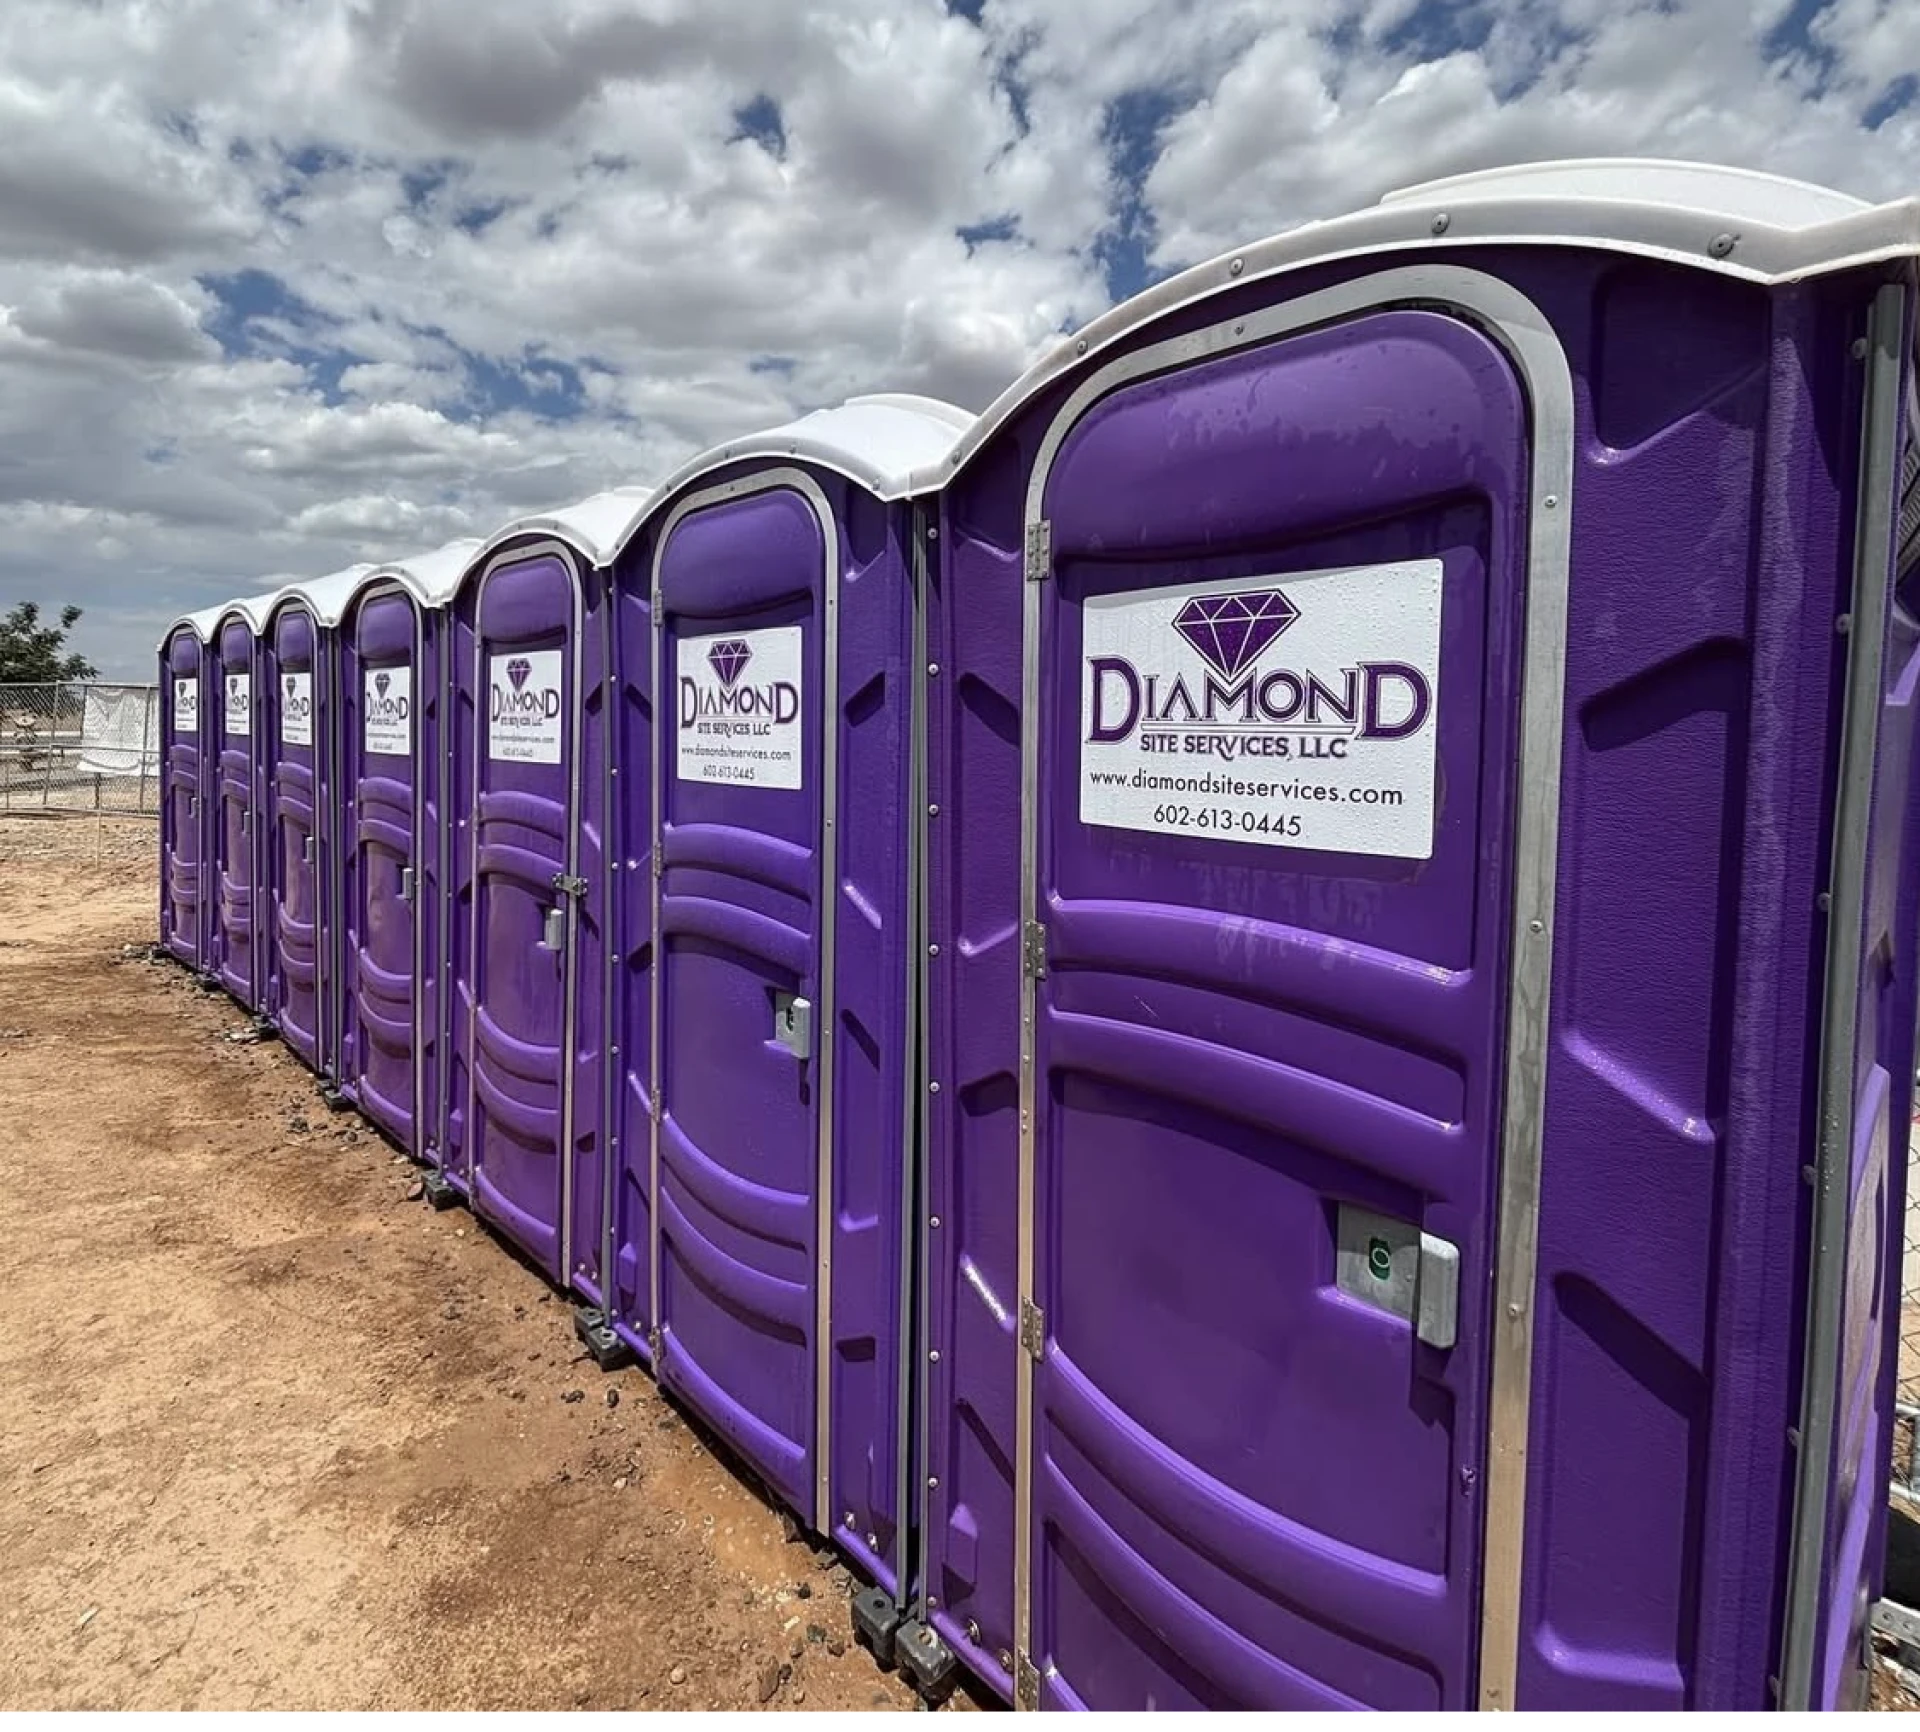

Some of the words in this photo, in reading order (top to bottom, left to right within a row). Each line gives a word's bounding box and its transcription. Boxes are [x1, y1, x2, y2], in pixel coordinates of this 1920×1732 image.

[680, 675, 799, 729] DIAMOND
[1085, 655, 1432, 742] DIAMOND
[753, 723, 771, 736] LLC
[1140, 734, 1178, 752] SITE
[1184, 735, 1294, 761] SERVICES,
[1299, 739, 1348, 759] LLC
[1090, 768, 1404, 806] www.diamondsiteservices.com
[1153, 804, 1302, 837] 602-613-0445
